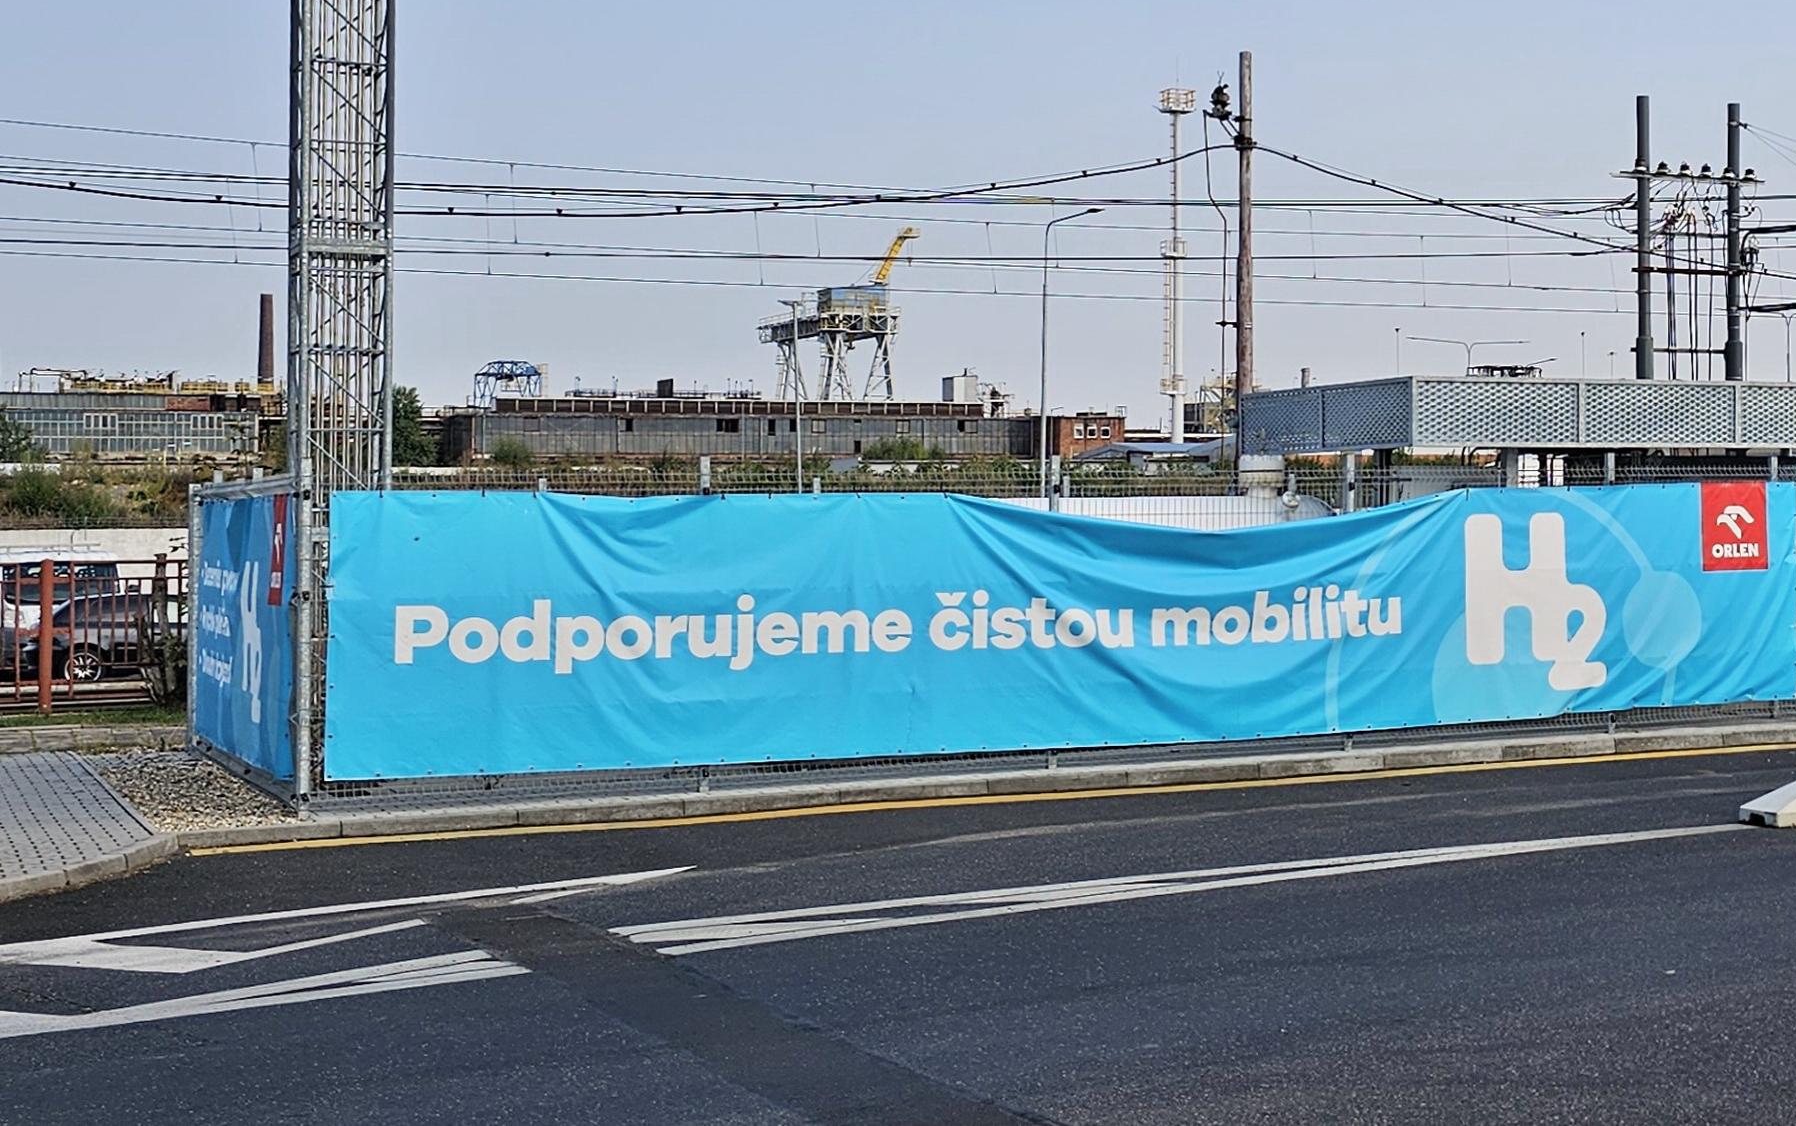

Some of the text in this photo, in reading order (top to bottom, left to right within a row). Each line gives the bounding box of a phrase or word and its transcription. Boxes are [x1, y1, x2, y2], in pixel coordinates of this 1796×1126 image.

[1711, 543, 1759, 558] ORLEN
[395, 585, 1401, 673] Podporujeme čistou mobilitu
